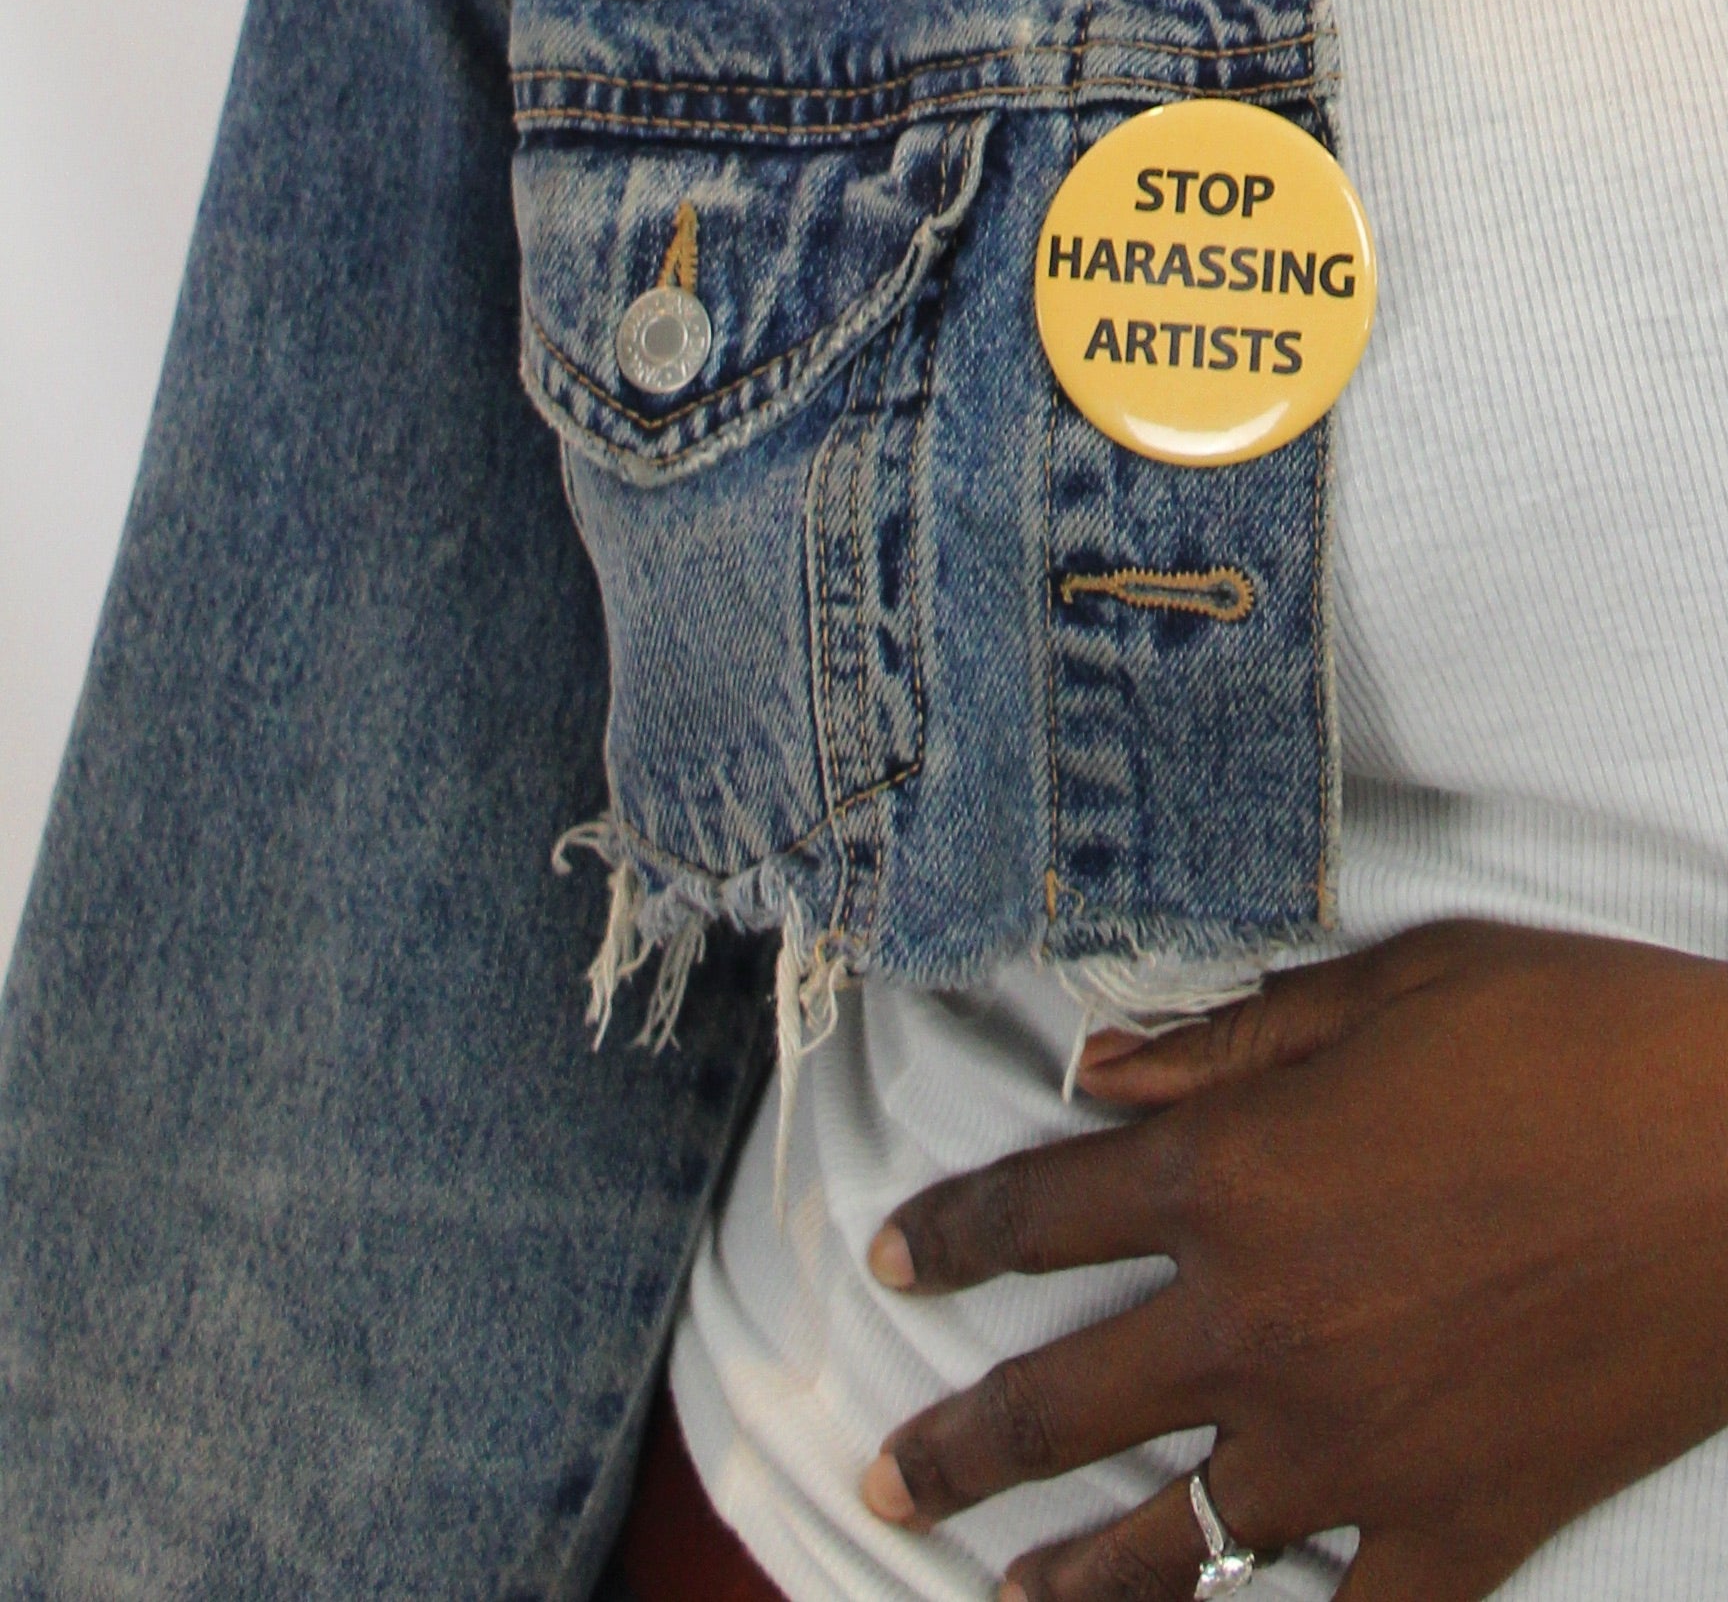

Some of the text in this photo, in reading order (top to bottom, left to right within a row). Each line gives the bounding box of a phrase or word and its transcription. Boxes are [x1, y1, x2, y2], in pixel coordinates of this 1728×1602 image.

[1134, 167, 1276, 218] STOP
[1048, 234, 1356, 299] HARASSING
[1083, 318, 1303, 375] ARTISTS
